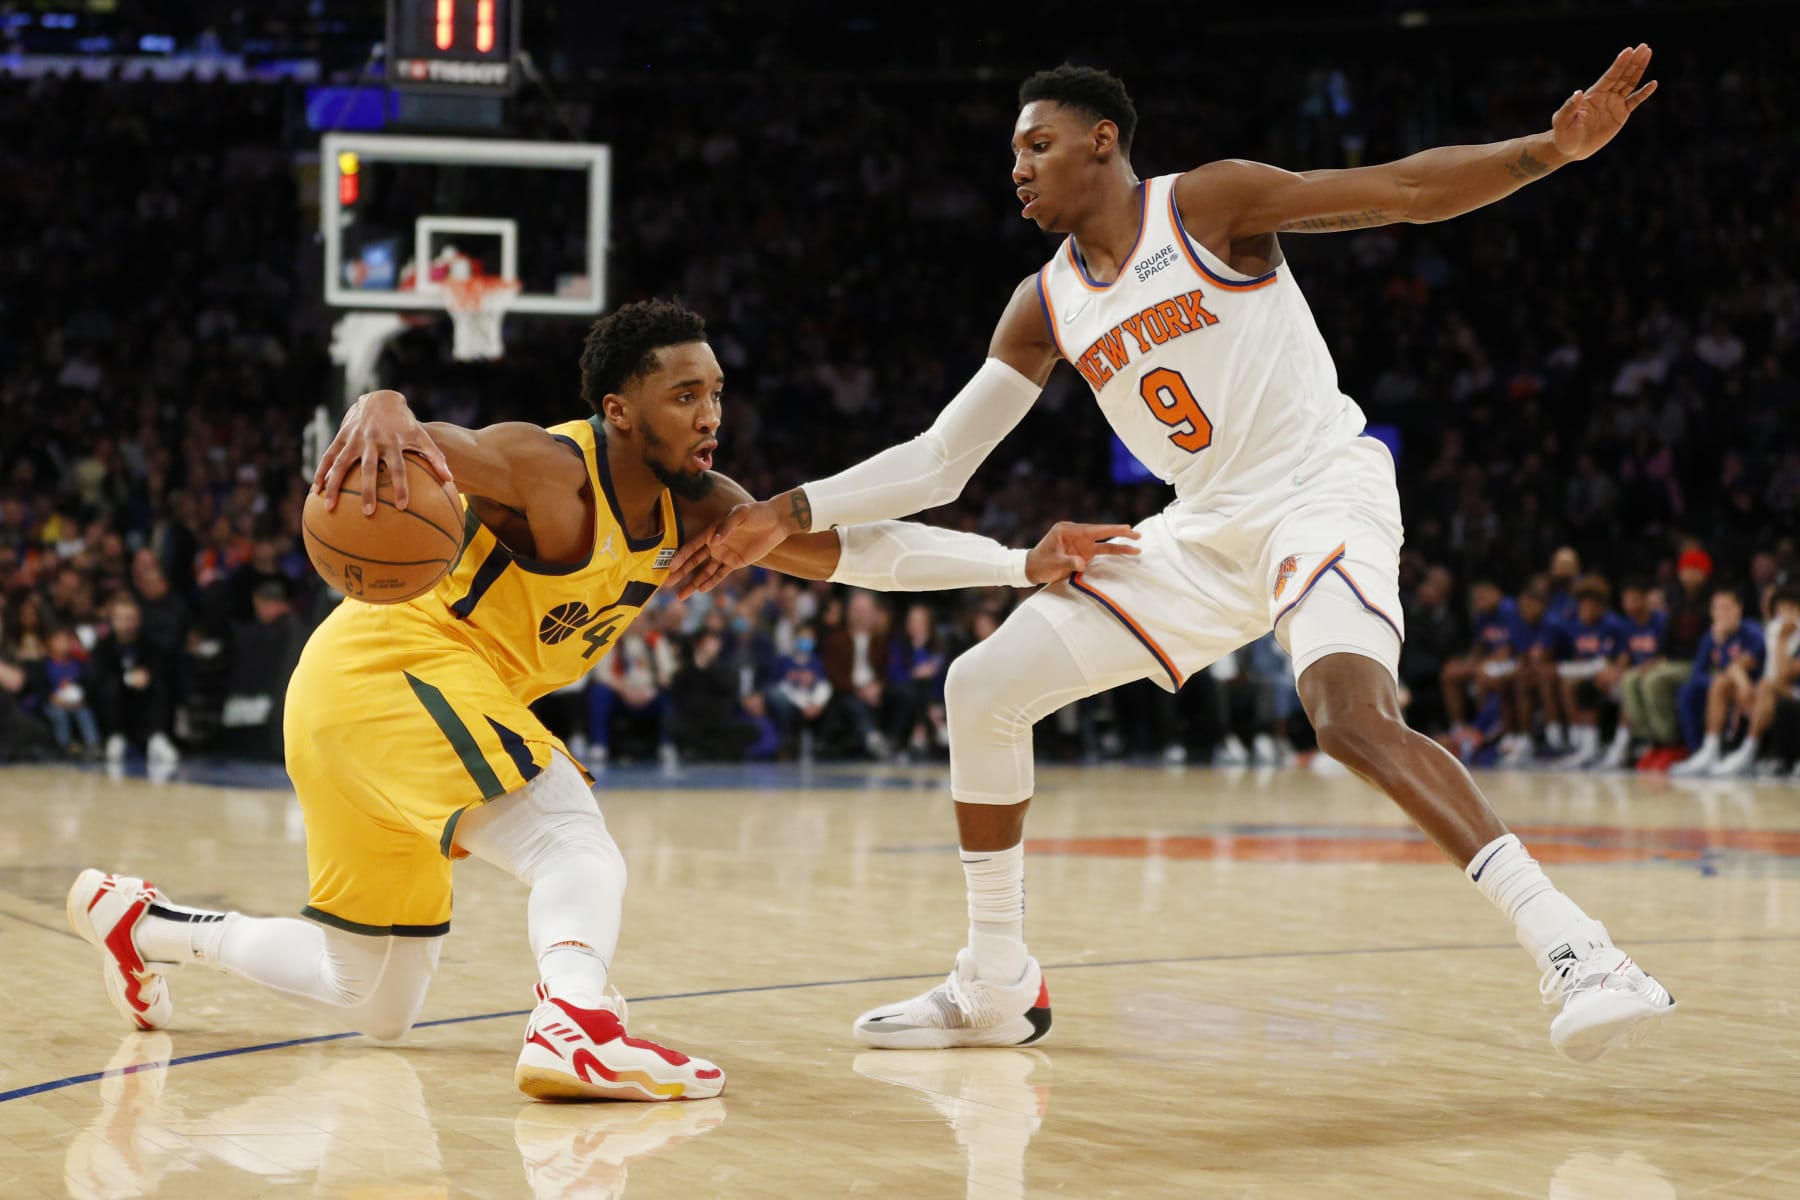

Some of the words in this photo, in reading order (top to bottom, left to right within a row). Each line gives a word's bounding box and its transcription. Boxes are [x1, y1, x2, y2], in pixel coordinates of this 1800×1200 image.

[435, 0, 495, 52] 11
[1134, 244, 1174, 274] SQUARE
[1138, 257, 1171, 283] SPACE
[1075, 325, 1130, 393] NEW
[1121, 289, 1220, 354] YORK
[1139, 366, 1214, 455] 9
